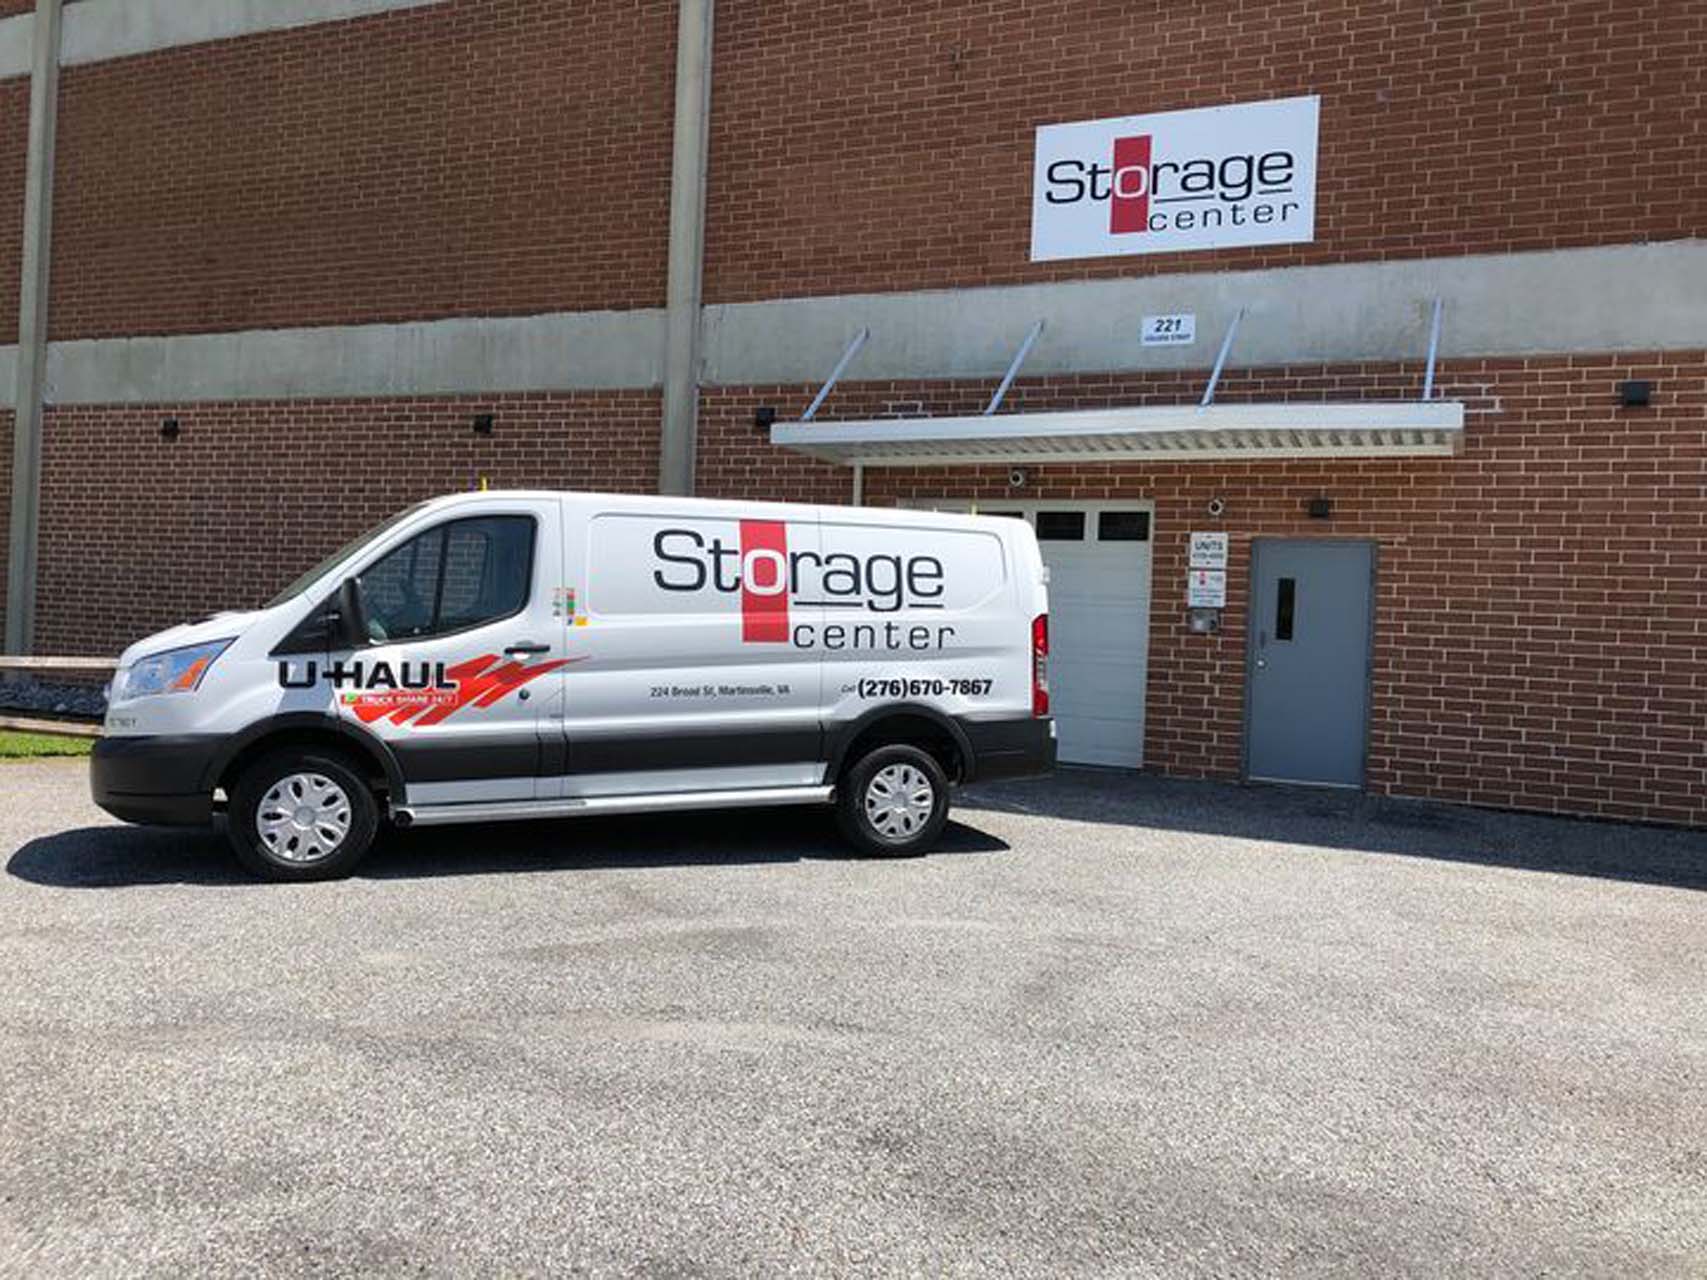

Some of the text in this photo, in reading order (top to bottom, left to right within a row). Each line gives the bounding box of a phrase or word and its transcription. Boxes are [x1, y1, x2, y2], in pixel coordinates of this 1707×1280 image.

[1045, 151, 1294, 204] Storage
[1148, 202, 1299, 231] center
[1155, 319, 1181, 332] 221
[653, 529, 944, 612] Storage
[793, 621, 955, 650] center
[279, 661, 457, 688] U-HAUL
[858, 678, 993, 699] (276)670-7867
[650, 687, 669, 697] 224
